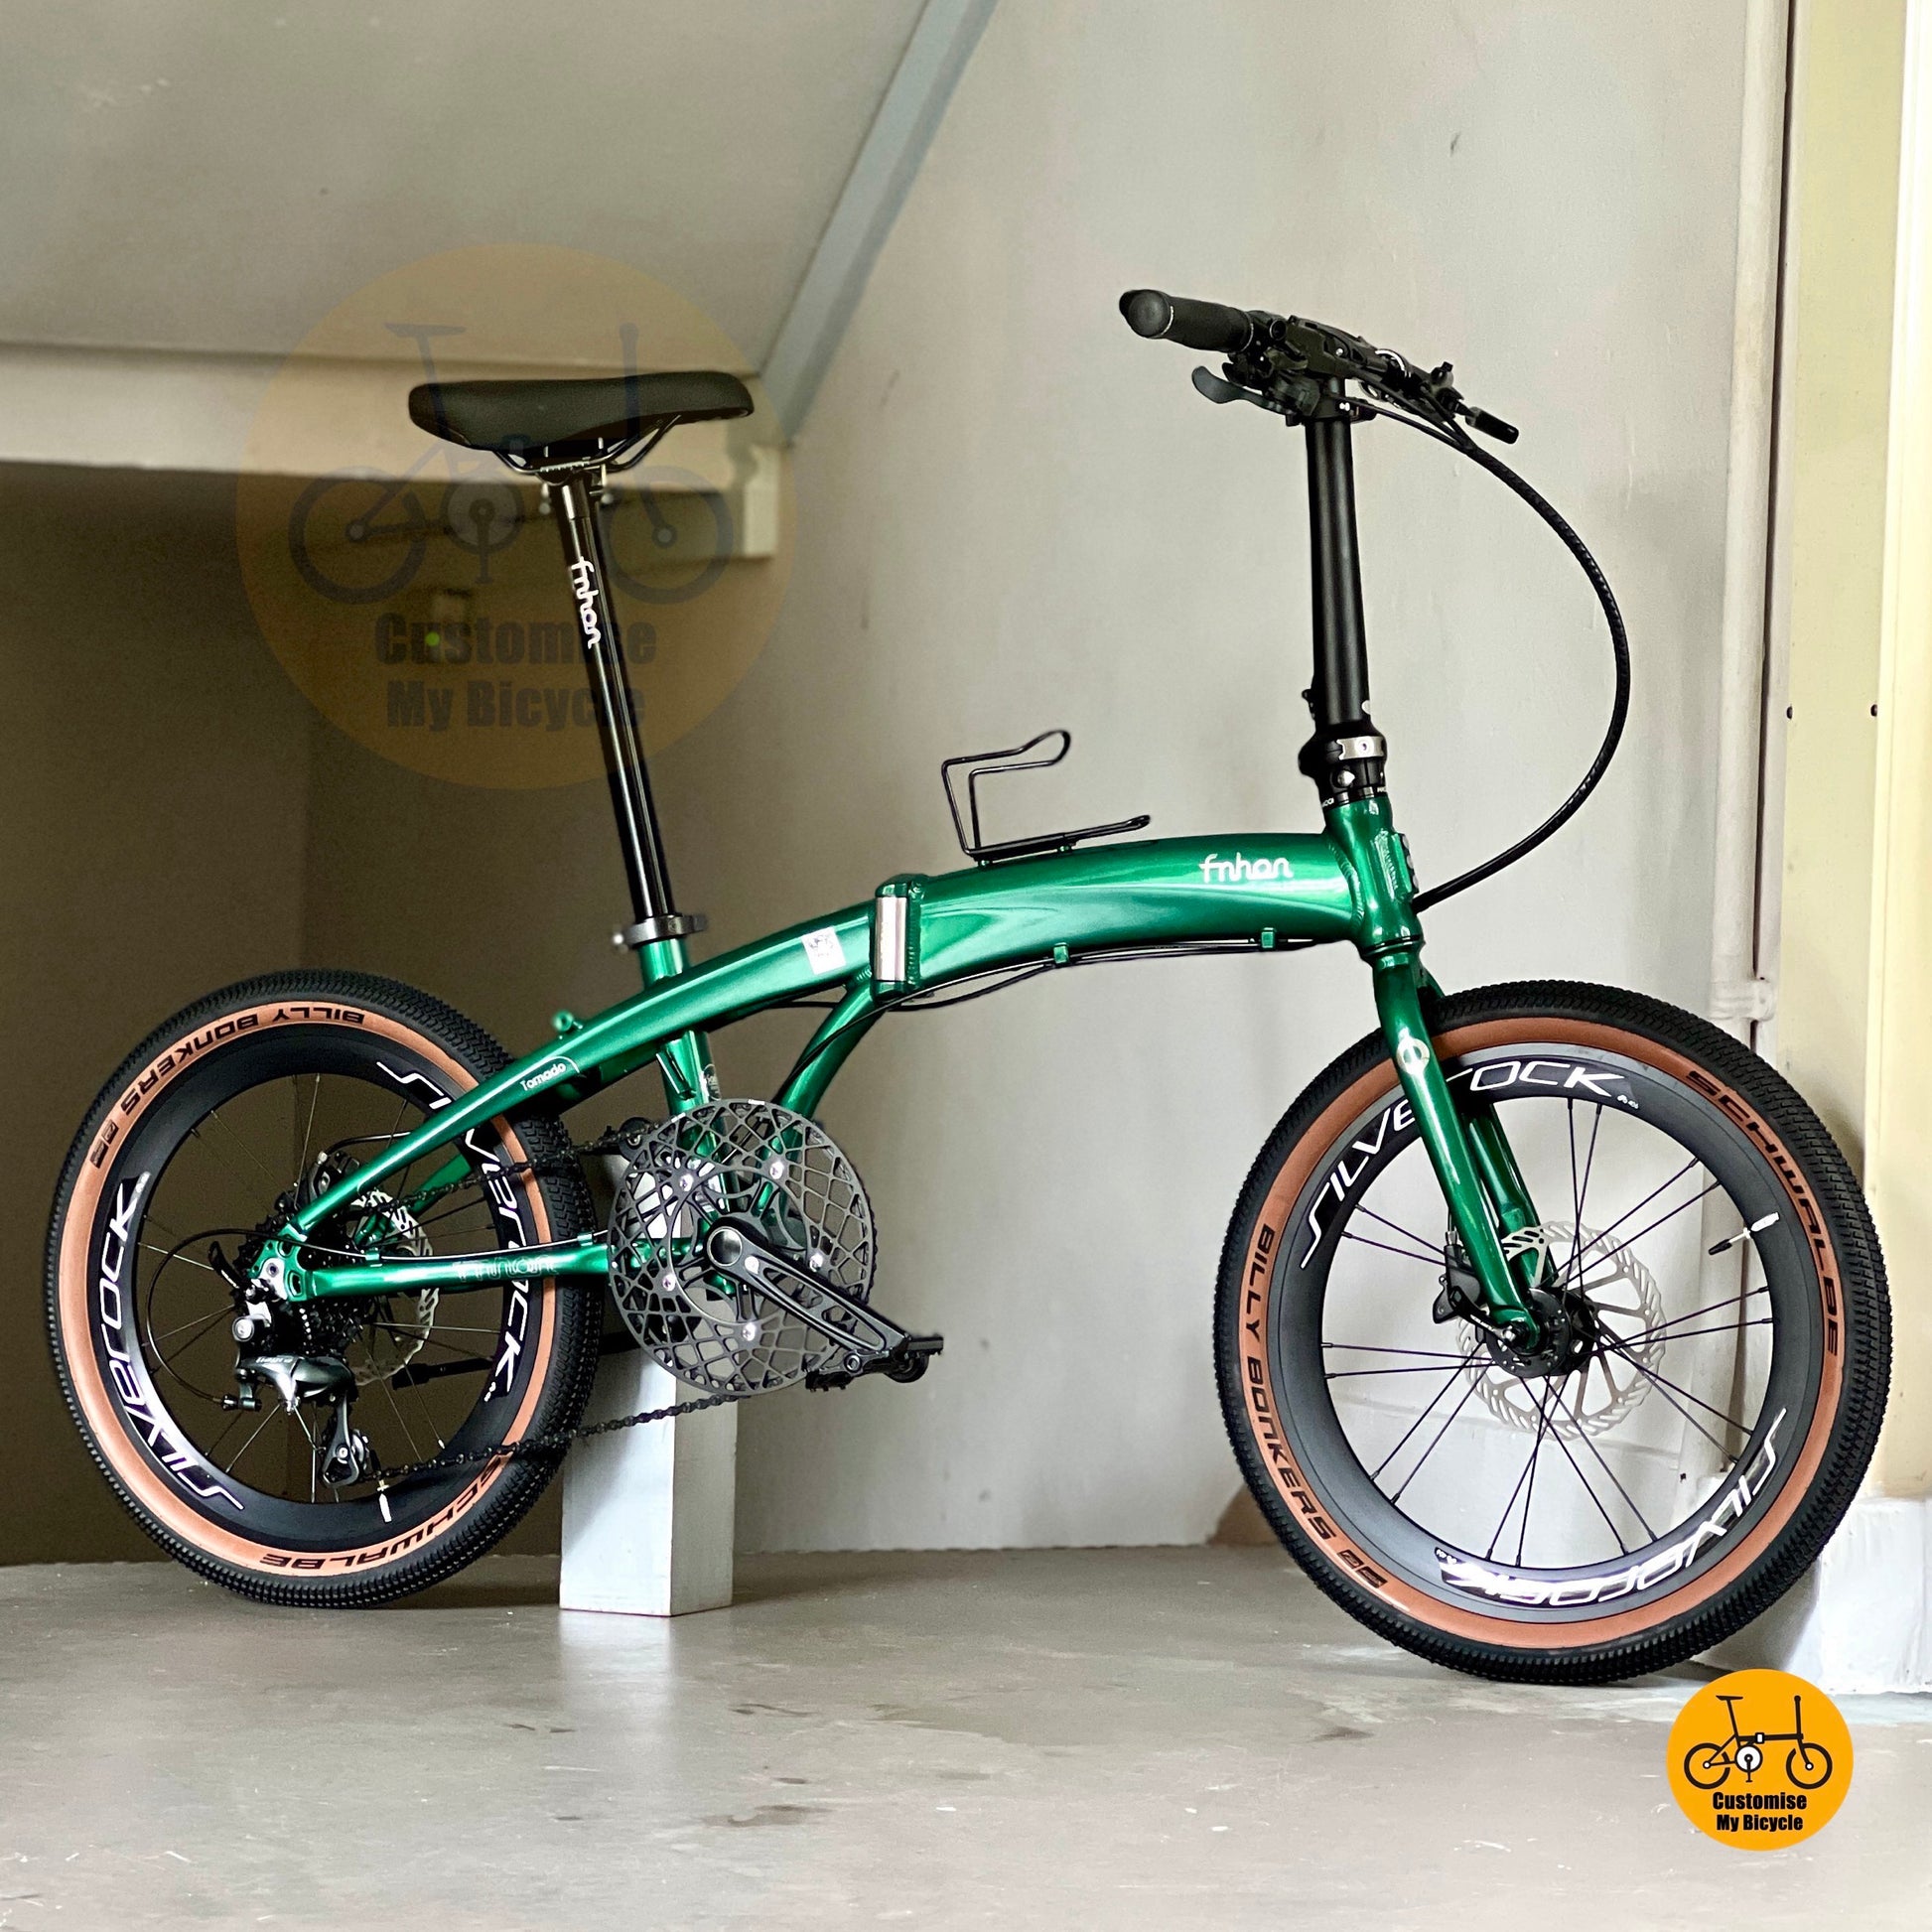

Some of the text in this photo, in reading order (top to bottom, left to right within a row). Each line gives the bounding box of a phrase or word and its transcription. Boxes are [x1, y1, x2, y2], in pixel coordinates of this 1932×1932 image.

[571, 556, 602, 650] fnhan
[1198, 851, 1295, 884] fnhan
[120, 1006, 365, 1116] BILLY BONKERS
[1686, 1069, 1838, 1357] SCHWALBE
[1245, 1222, 1337, 1542] BILLY BONKERS
[259, 1452, 503, 1572] SCHWALBE
